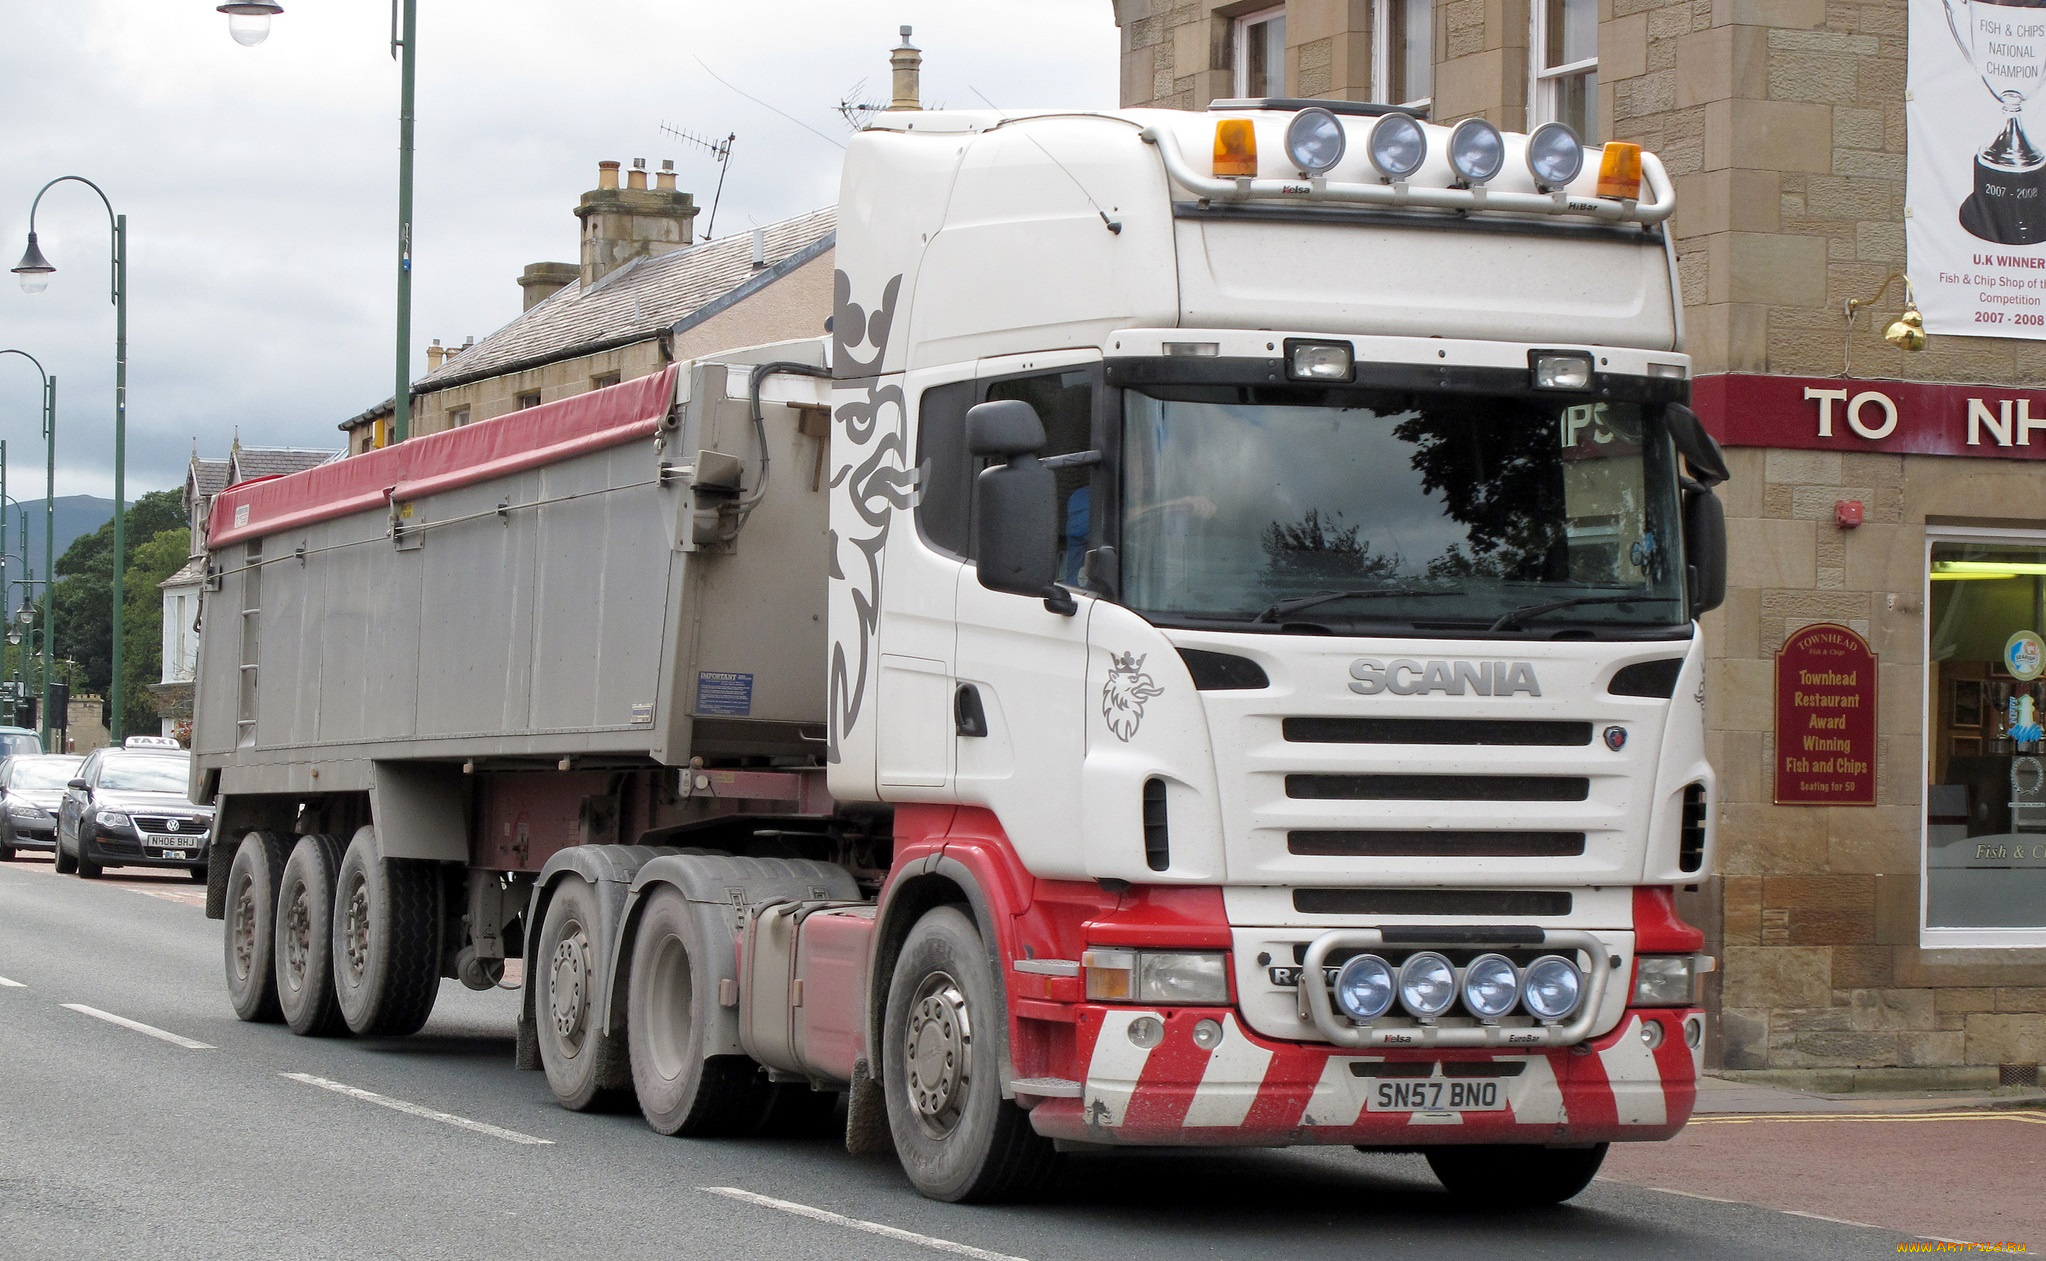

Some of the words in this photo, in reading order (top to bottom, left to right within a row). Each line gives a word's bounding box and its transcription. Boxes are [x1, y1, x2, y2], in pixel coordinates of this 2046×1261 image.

[1980, 19, 2000, 34] FISH
[2005, 24, 2012, 36] &
[2017, 25, 2045, 37] CHIPS
[1988, 42, 2035, 58] NATIONAL
[1986, 62, 2038, 78] CHAMPION
[1282, 185, 1310, 195] Kelsa
[1985, 184, 2006, 197] 2007
[2016, 188, 2038, 199] 2008
[1568, 202, 1598, 212] HiBar
[1973, 254, 1993, 266] U.K
[1997, 256, 2045, 269] WINNER
[1939, 272, 1959, 284] Fish
[1963, 274, 1971, 284] &
[1974, 275, 1996, 288] Chip
[1999, 276, 2024, 289] Shop
[2027, 278, 2037, 289] of
[1980, 292, 2040, 306] Competition
[1974, 311, 2004, 323] 2007
[2014, 314, 2044, 326] 2008
[1797, 634, 1858, 651] TOWNHEAD
[700, 672, 737, 680] IMPORTANT
[1348, 658, 1541, 696] SCANIA
[1800, 670, 1856, 686] Townhead
[1794, 691, 1860, 708] Restaurant
[1809, 714, 1846, 729] Award
[1803, 736, 1851, 753] Winning
[1786, 757, 1809, 773] Fish
[1812, 758, 1833, 773] and
[1837, 758, 1868, 776] Chips
[1800, 781, 1829, 792] Seating
[1831, 782, 1843, 791] for
[1845, 781, 1855, 791] 50
[152, 837, 174, 845] NH06
[177, 838, 194, 846] BHJ
[1975, 844, 2007, 859] Fish
[2013, 845, 2024, 859] &
[1384, 1034, 1412, 1043] Kelsa
[1509, 1034, 1540, 1043] EuroBar
[1378, 1083, 1443, 1107] SN57
[1450, 1082, 1497, 1106] BNO
